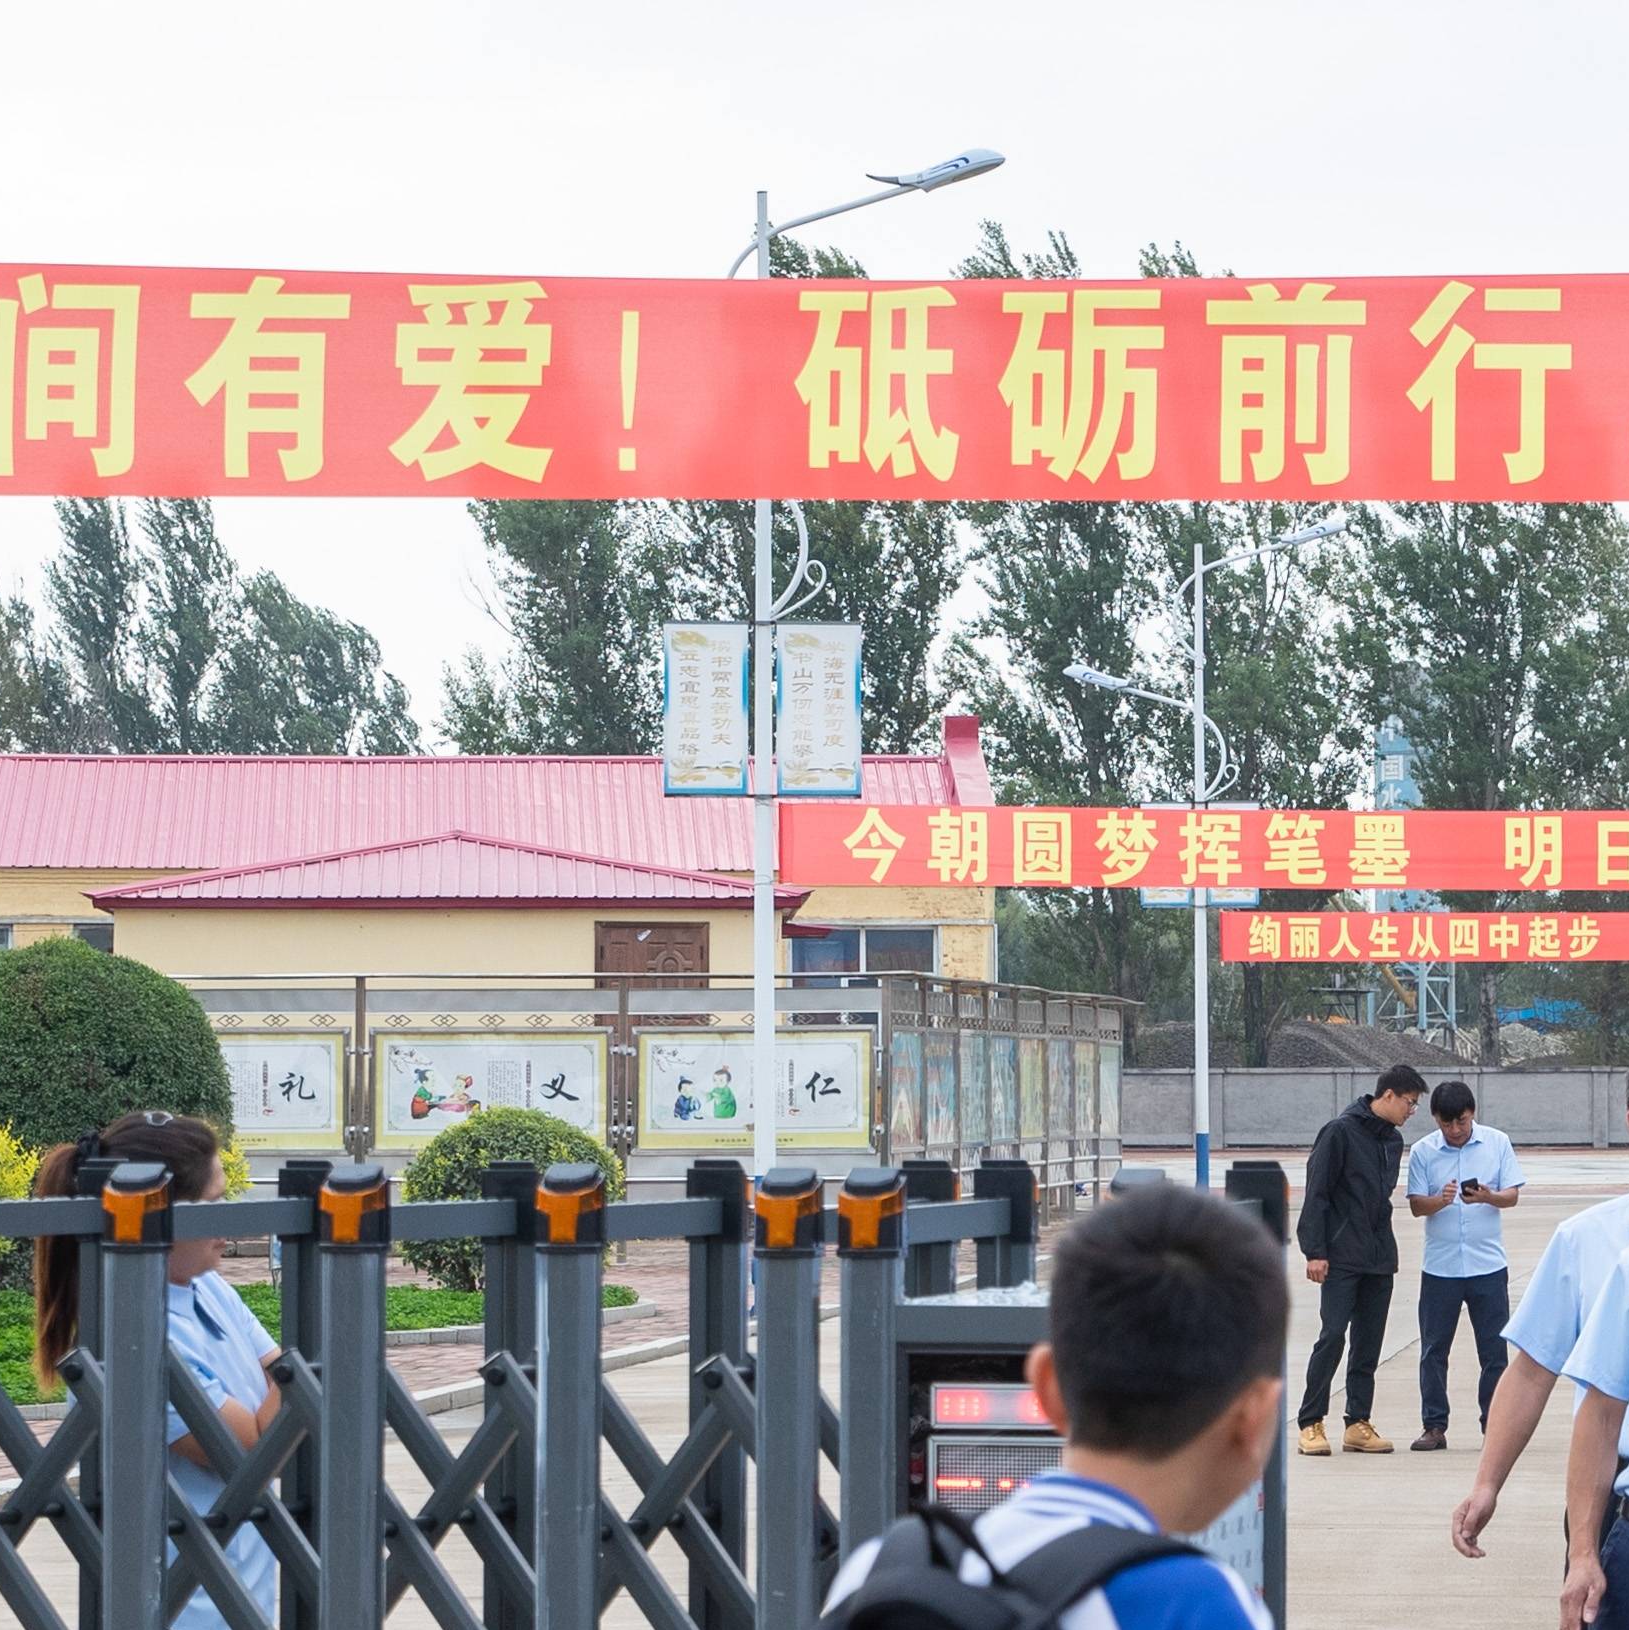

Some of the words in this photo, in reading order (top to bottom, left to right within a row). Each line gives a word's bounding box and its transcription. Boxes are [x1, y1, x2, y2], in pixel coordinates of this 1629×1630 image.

[844, 807, 1411, 885] 今朝圆梦挥笔墨
[1248, 915, 1601, 960] 绚丽人生从四中起步
[278, 1072, 316, 1102] 礼
[539, 1073, 580, 1102] 义
[805, 1071, 842, 1103] 仁
